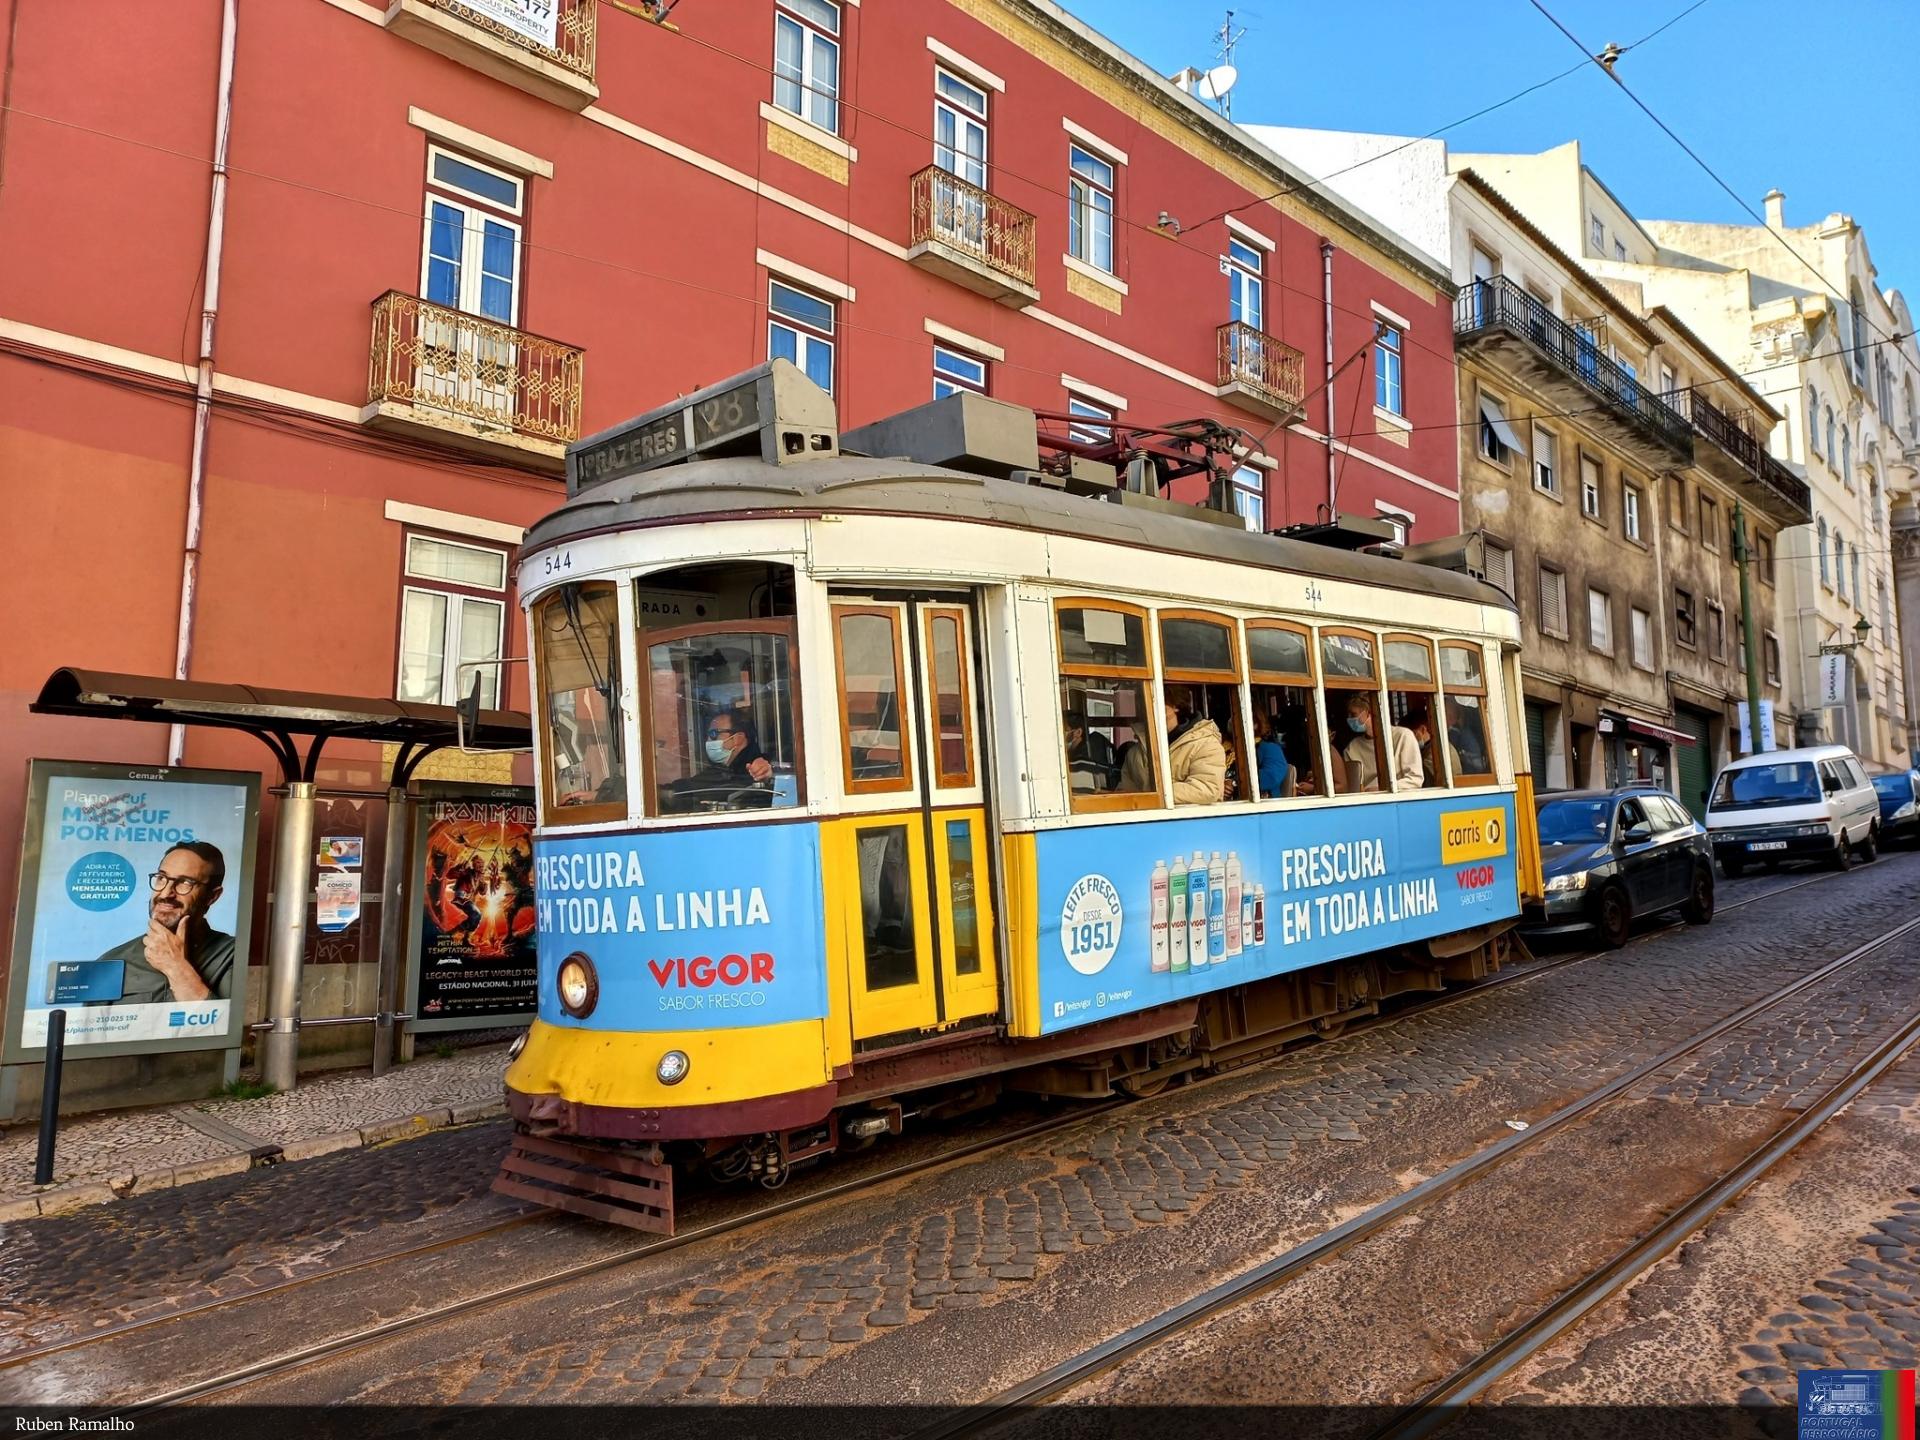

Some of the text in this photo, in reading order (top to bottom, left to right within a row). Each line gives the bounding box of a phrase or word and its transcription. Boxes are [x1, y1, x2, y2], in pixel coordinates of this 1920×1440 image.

[504, 7, 549, 34] PROPERTY
[545, 551, 572, 575] 544
[1305, 587, 1322, 602] 544
[642, 601, 681, 615] RADA
[128, 771, 164, 780] Cemark
[63, 789, 109, 803] Plano
[125, 809, 171, 825] CUF
[435, 801, 487, 826] IRON
[61, 825, 107, 841] POR
[1447, 819, 1480, 846] carris
[537, 850, 645, 890] FRESCURA
[1282, 838, 1386, 891] FRESCURA
[1456, 864, 1495, 889] VIGOR
[1064, 877, 1120, 921] LEITE FRESCO
[538, 887, 770, 934] EM TODA A LINHA
[1083, 909, 1102, 921] DESDE
[1282, 877, 1439, 945] EM TODA A LINHA
[1152, 922, 1168, 930] VIGOR
[1171, 920, 1187, 928] VIGOR
[1191, 918, 1206, 927] VIGOR
[1071, 921, 1114, 955] 1951
[425, 971, 457, 980] LEGACY
[464, 970, 489, 979] BEAST
[491, 969, 521, 977] WORLD
[648, 953, 775, 989] VIGOR
[439, 981, 470, 989] ESTÁDIO
[658, 991, 766, 1011] SABOR FRESCO
[187, 1009, 218, 1026] cuf
